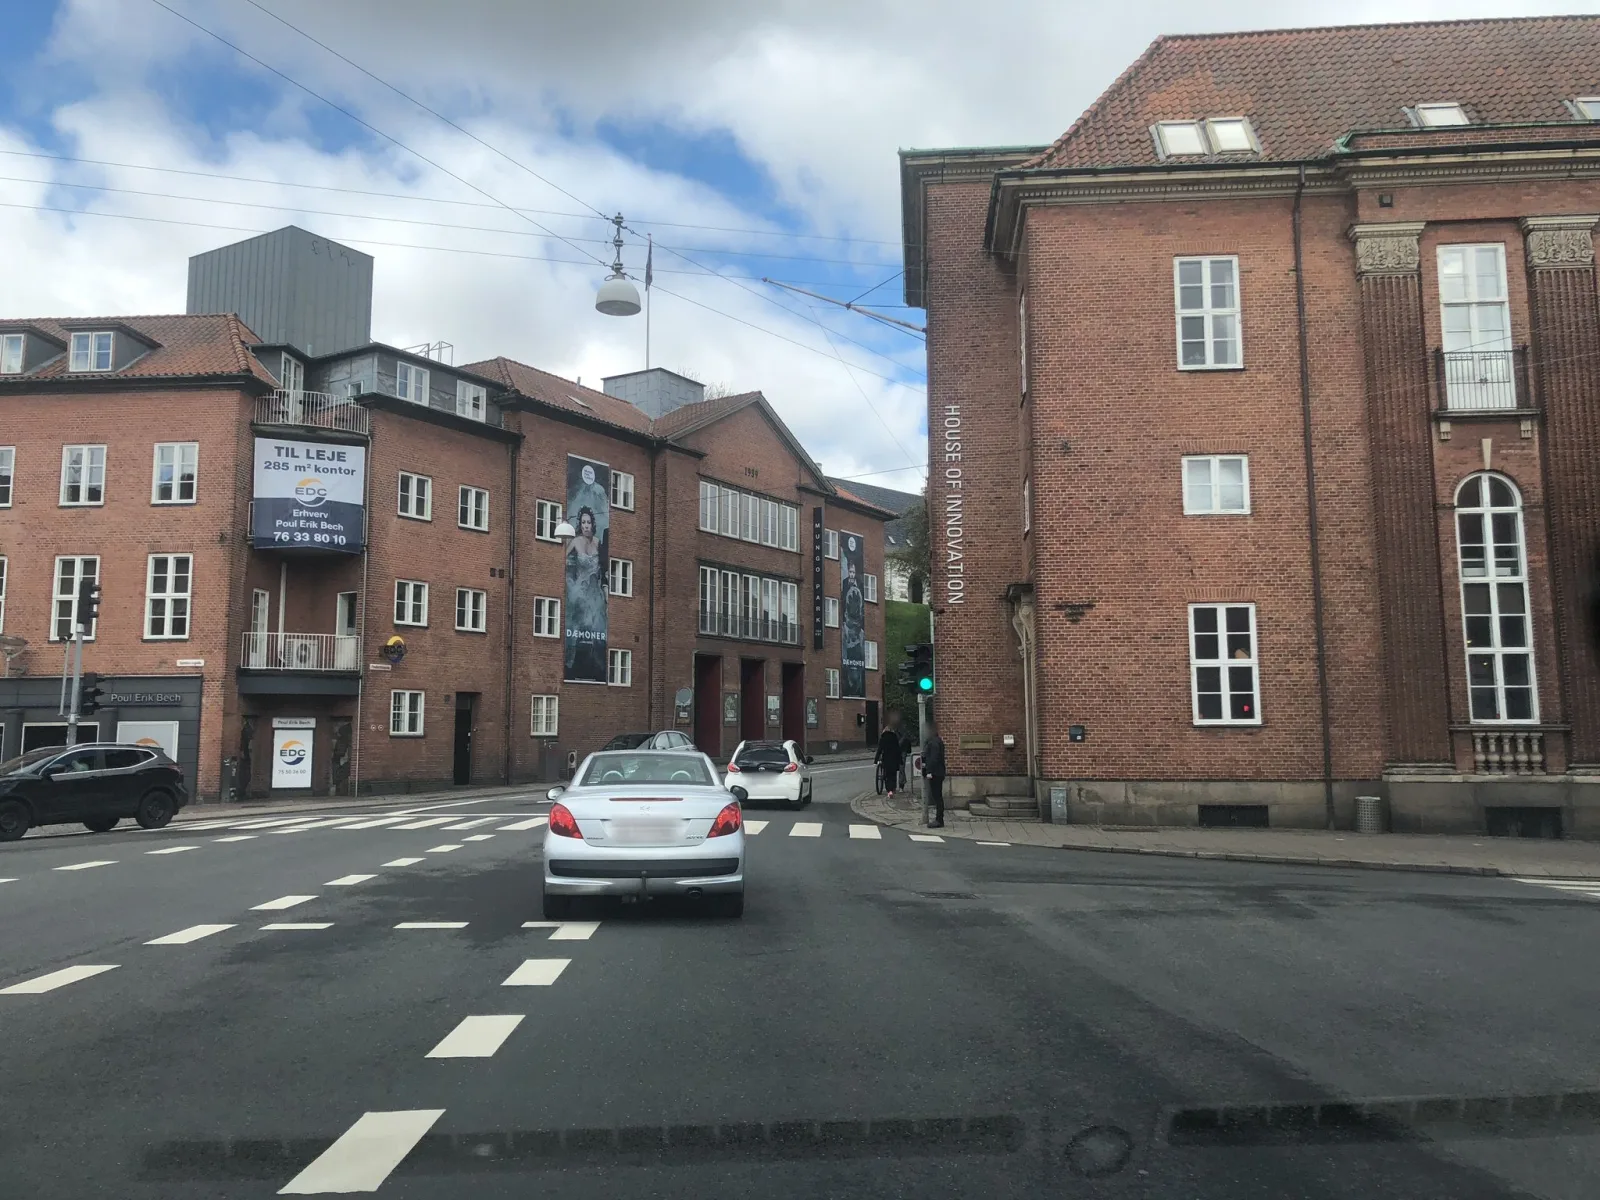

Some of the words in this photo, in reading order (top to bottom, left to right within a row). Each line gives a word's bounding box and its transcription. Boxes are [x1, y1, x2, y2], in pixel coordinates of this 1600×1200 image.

[945, 405, 961, 462] HOUSE
[274, 446, 300, 459] TIL
[306, 448, 347, 462] LEJE
[264, 461, 290, 471] 285
[314, 464, 356, 476] kontor
[945, 469, 962, 488] OF
[295, 487, 327, 497] EDC
[292, 509, 329, 519] Erhverv
[276, 519, 297, 528] Poul
[299, 520, 318, 529] Erik
[320, 521, 344, 531] Bech
[273, 531, 290, 542] 76
[293, 532, 310, 542] 33
[313, 533, 330, 543] 80
[332, 534, 347, 546] 10
[946, 495, 964, 604] INNOVATION
[110, 693, 132, 702] Poul
[135, 693, 154, 702] Erik
[156, 693, 181, 702] Bech
[280, 749, 306, 757] EDC
